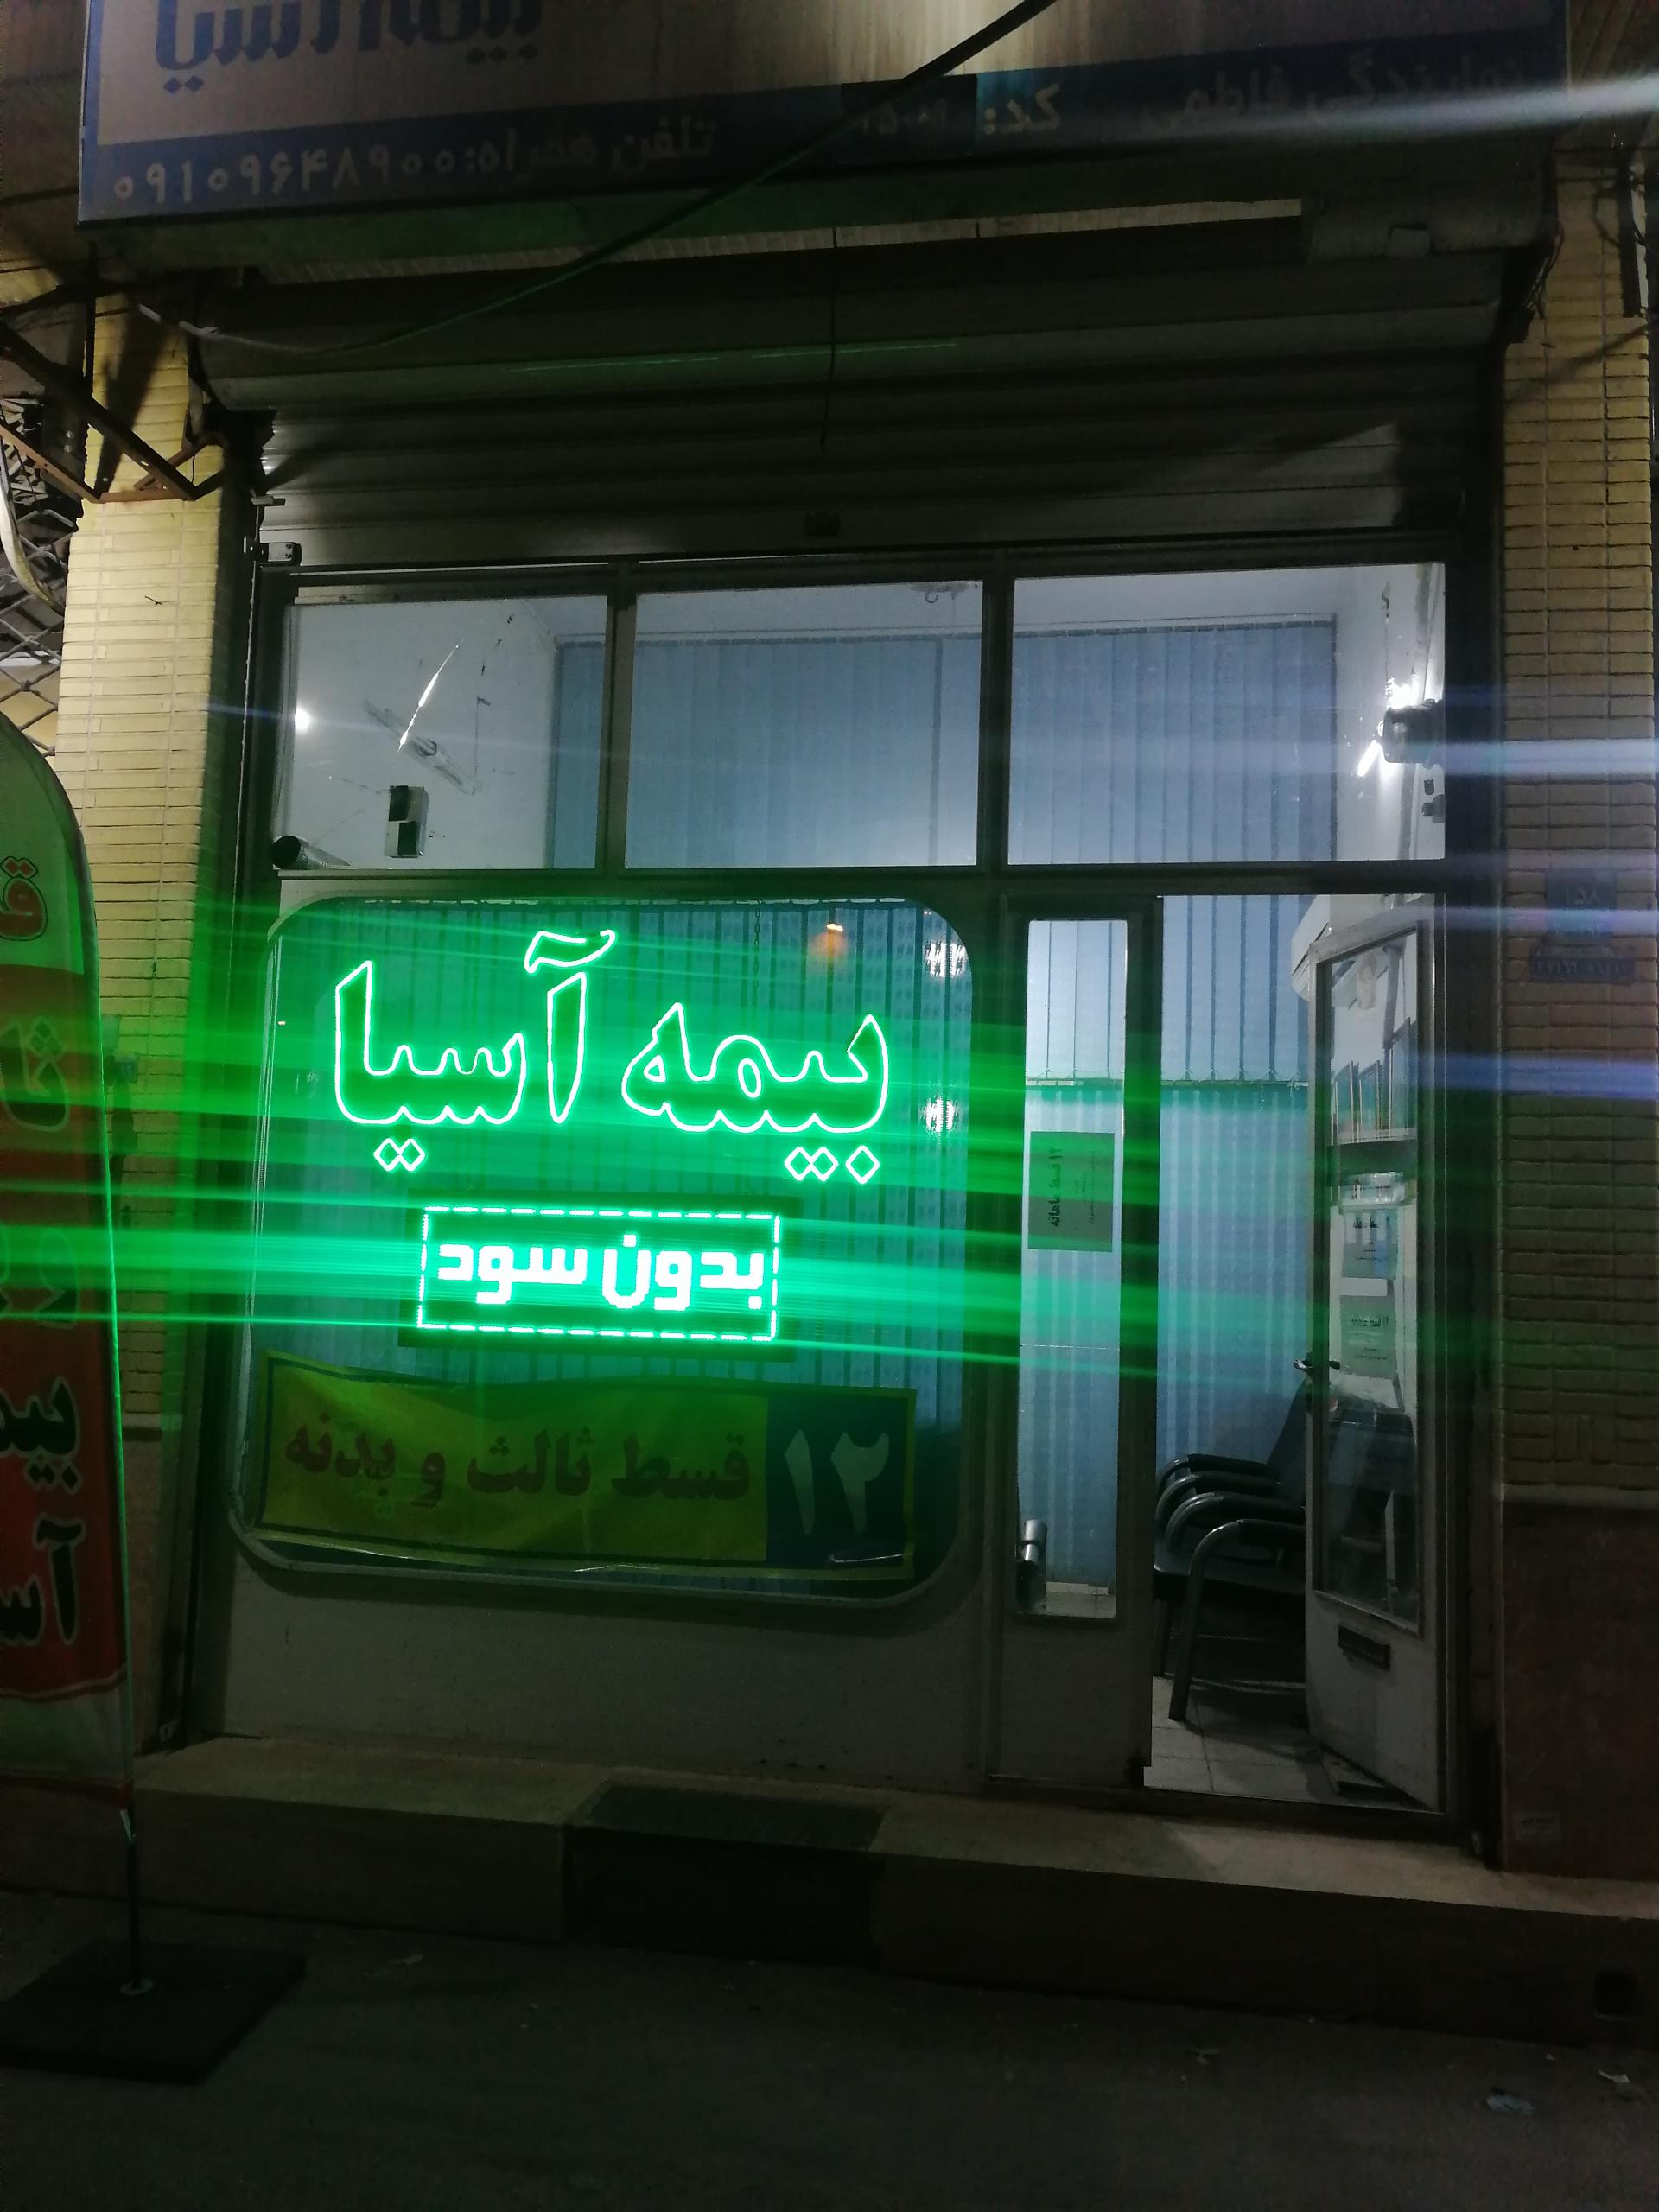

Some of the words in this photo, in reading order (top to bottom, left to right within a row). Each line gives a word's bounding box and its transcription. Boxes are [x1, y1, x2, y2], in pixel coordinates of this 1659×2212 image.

[334, 928, 617, 1173] آسیا
[620, 1001, 891, 1185] بیمه
[436, 1242, 588, 1306] سود
[600, 1233, 766, 1313] بدون
[283, 1410, 399, 1501] بدنه
[410, 1443, 448, 1508] و
[467, 1425, 593, 1497] ثالث
[611, 1431, 751, 1501] قسط
[783, 1427, 891, 1535] ۱۲
